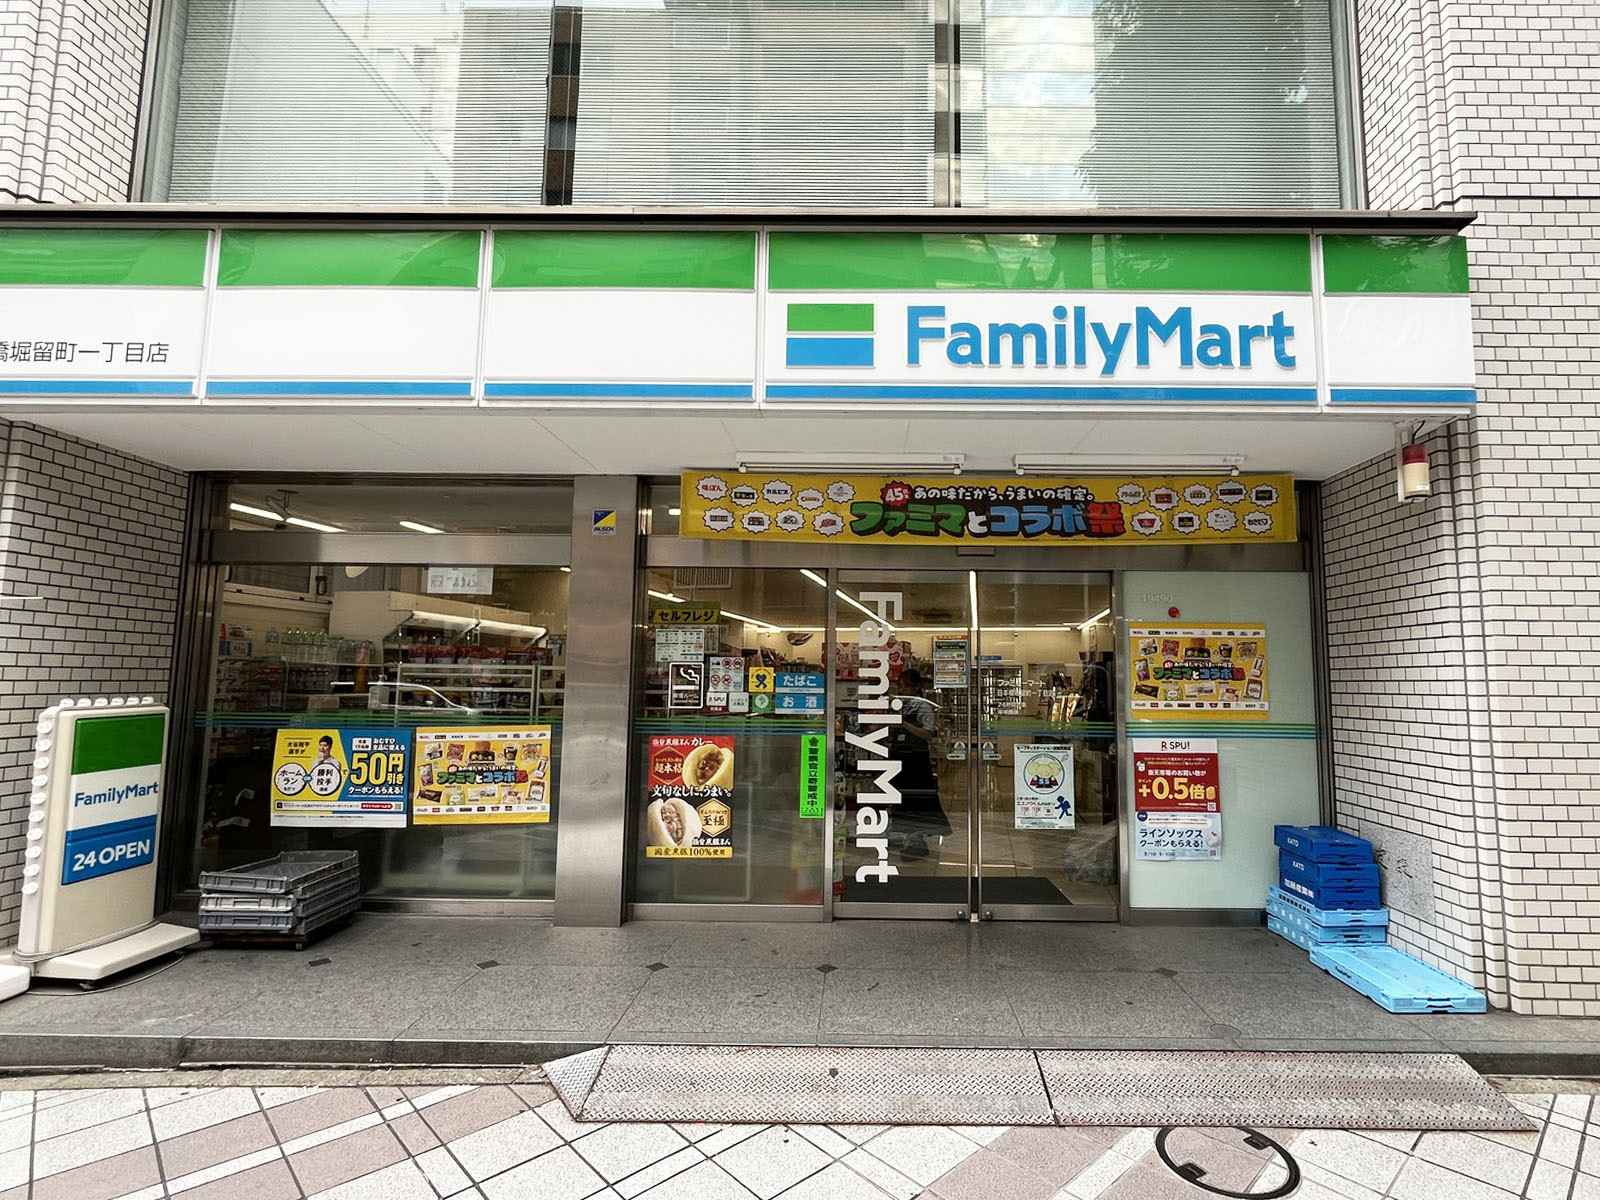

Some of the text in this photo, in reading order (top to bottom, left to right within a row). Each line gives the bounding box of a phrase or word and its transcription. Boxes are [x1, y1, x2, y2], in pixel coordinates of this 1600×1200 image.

[906, 305, 1297, 377] FamilyMart
[914, 486, 1095, 501] あの味だから、うまいの確定。
[850, 502, 1126, 536] ファミマとコラボ祭
[659, 610, 715, 622] セルフレジ
[783, 674, 817, 686] たばこ
[783, 696, 817, 708] お酒
[691, 737, 713, 746] カレー
[845, 591, 903, 883] FamilyMart
[279, 769, 303, 777] ホーム
[317, 769, 333, 777] 勝利
[350, 752, 404, 785] 50円
[283, 777, 298, 785] ラン
[316, 778, 332, 786] 投手
[387, 773, 404, 785] 引き
[74, 781, 159, 807] FamilyMart
[651, 784, 732, 798] 文句なしに、うまい。
[1139, 828, 1203, 838] ラインソックス
[1287, 837, 1299, 847] KATO
[72, 839, 151, 872] 24 OPEN
